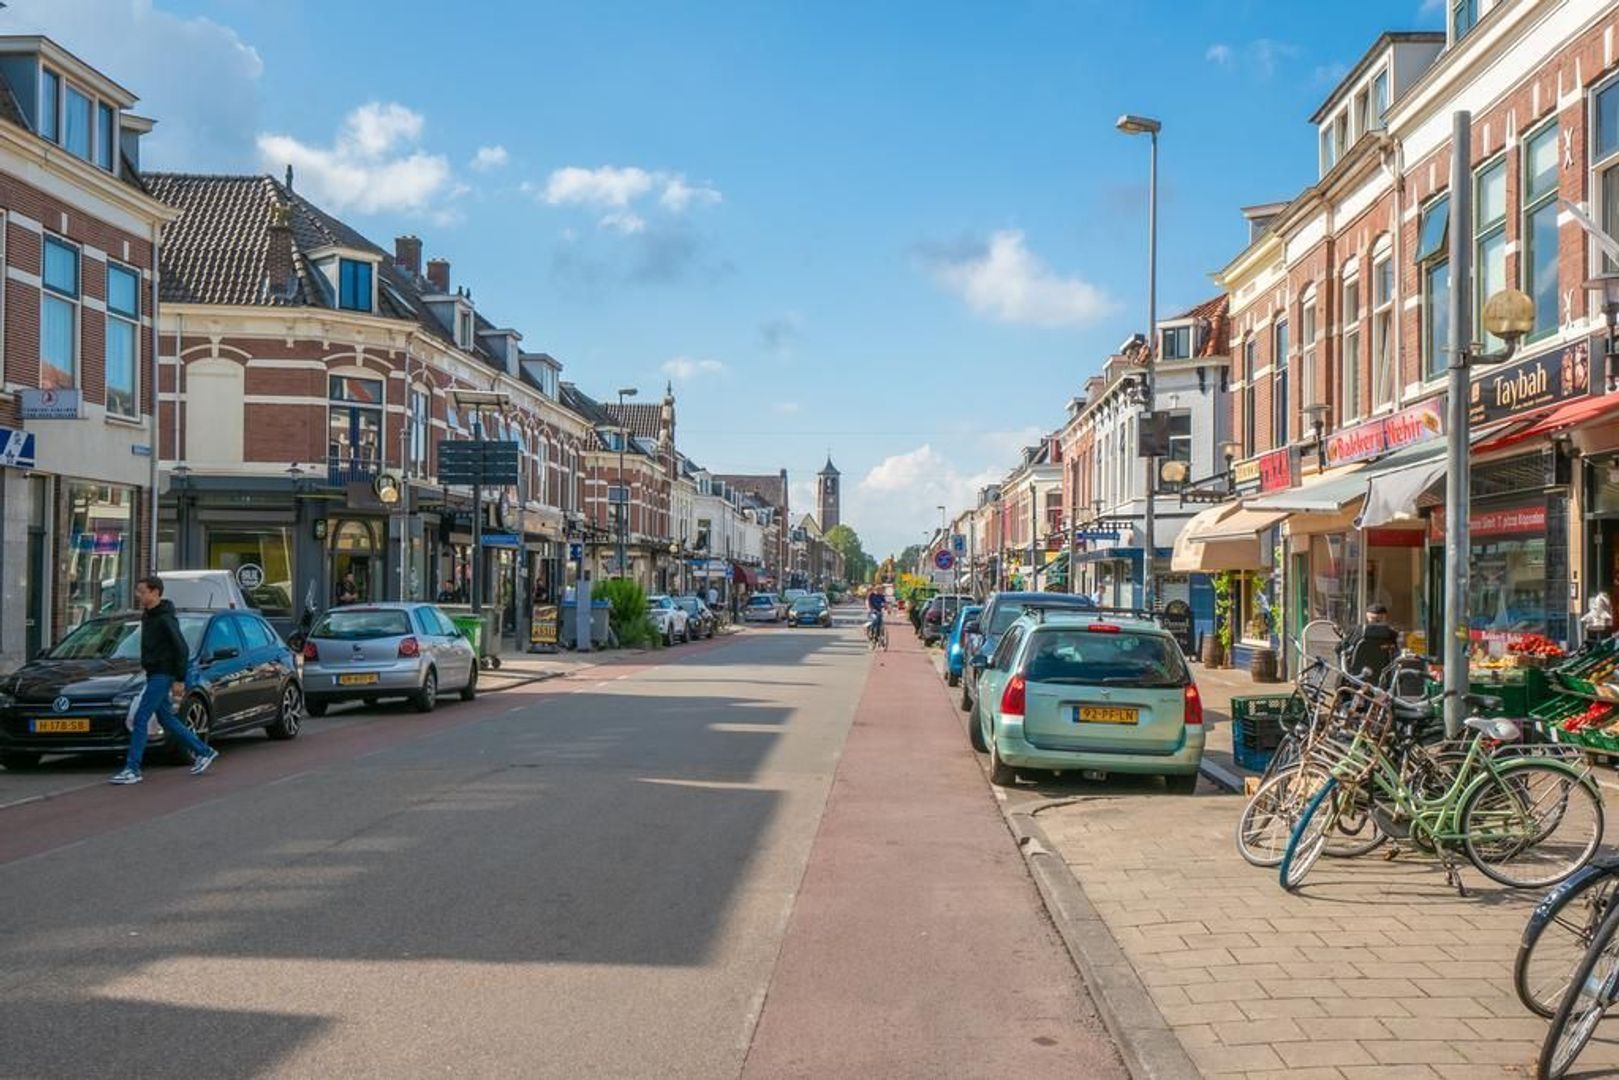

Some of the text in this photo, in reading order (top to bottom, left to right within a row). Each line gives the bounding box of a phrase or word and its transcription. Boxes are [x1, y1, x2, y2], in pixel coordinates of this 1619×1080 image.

[1493, 362, 1547, 410] Taybah
[1386, 414, 1422, 445] Nehir
[1083, 707, 1134, 721] 92-PF-LN
